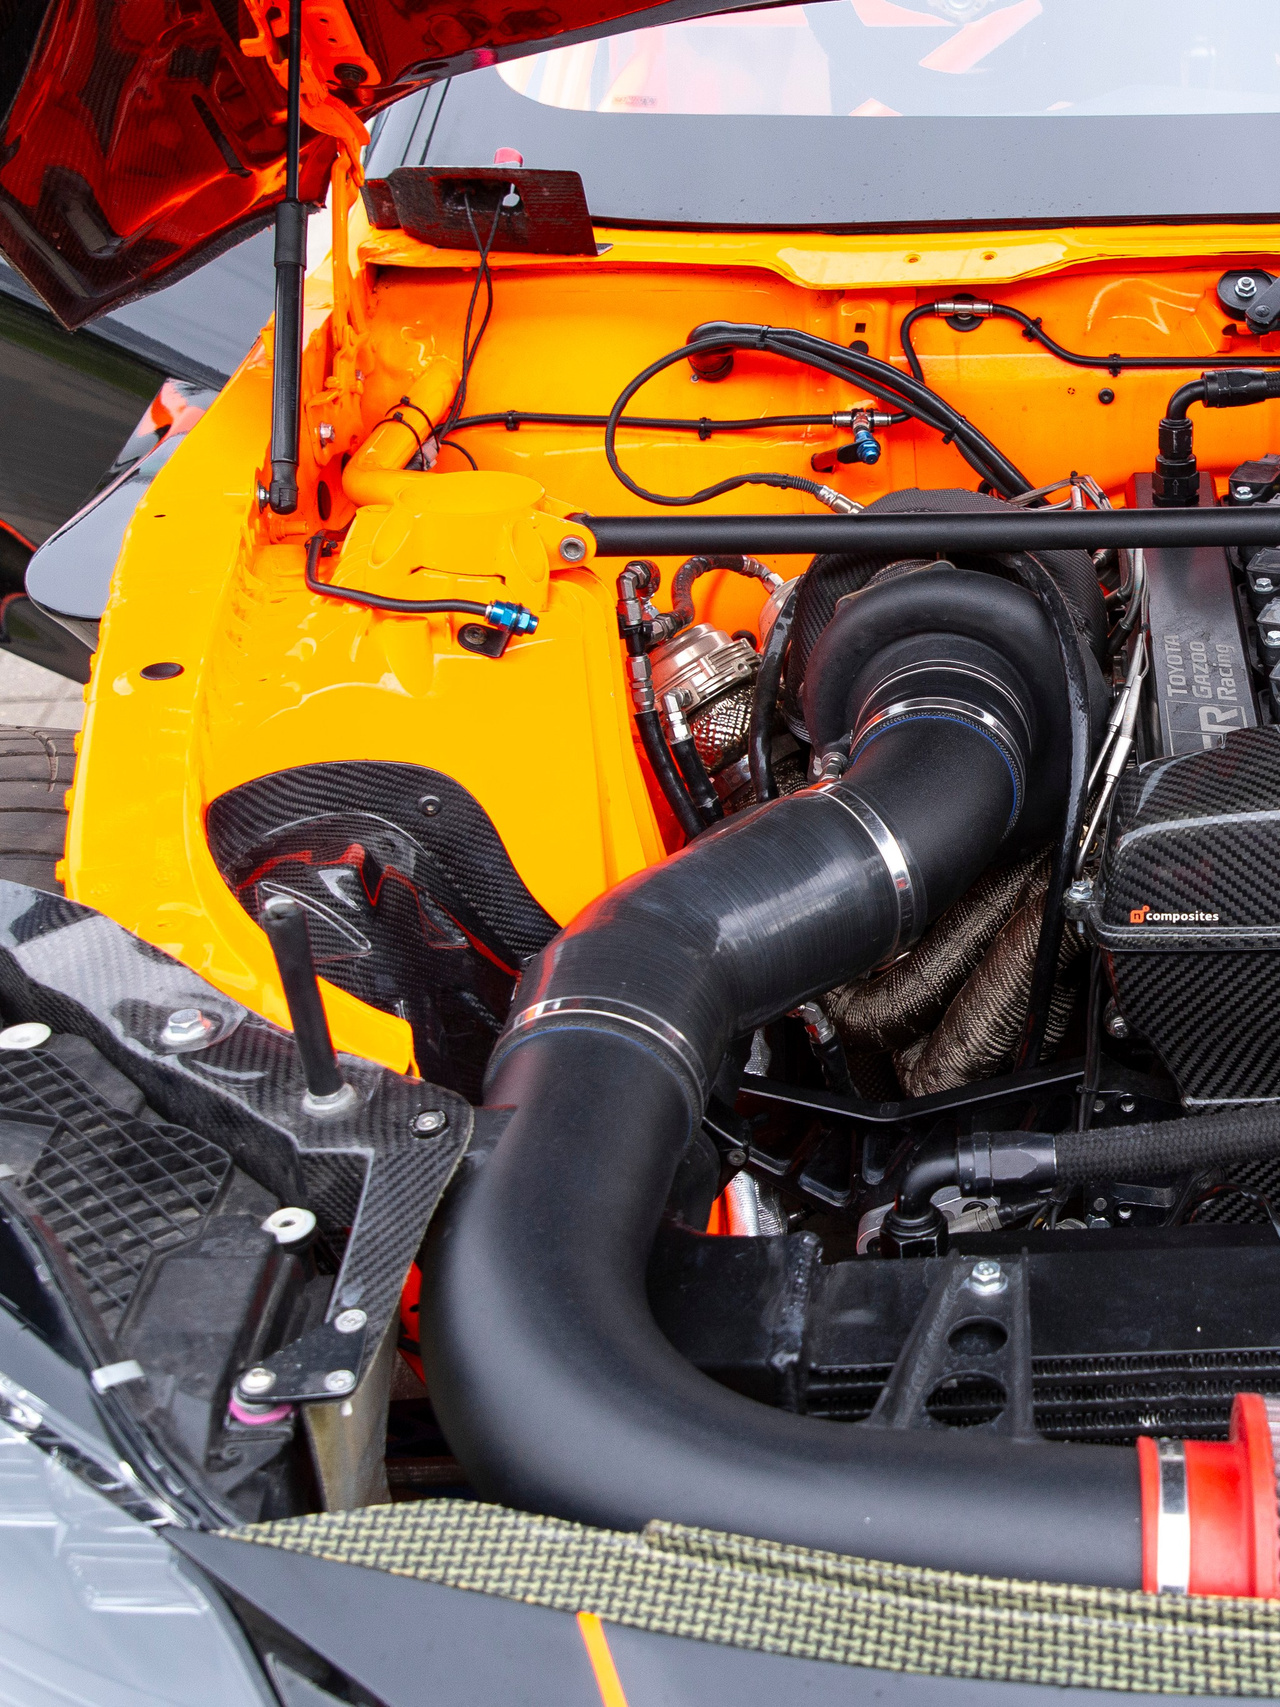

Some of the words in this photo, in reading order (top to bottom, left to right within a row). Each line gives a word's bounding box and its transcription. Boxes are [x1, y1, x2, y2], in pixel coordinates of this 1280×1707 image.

[1164, 634, 1188, 697] TOYOTA
[1189, 641, 1213, 699] GAZOO
[1213, 644, 1237, 701] Racing
[1145, 910, 1220, 924] composites
